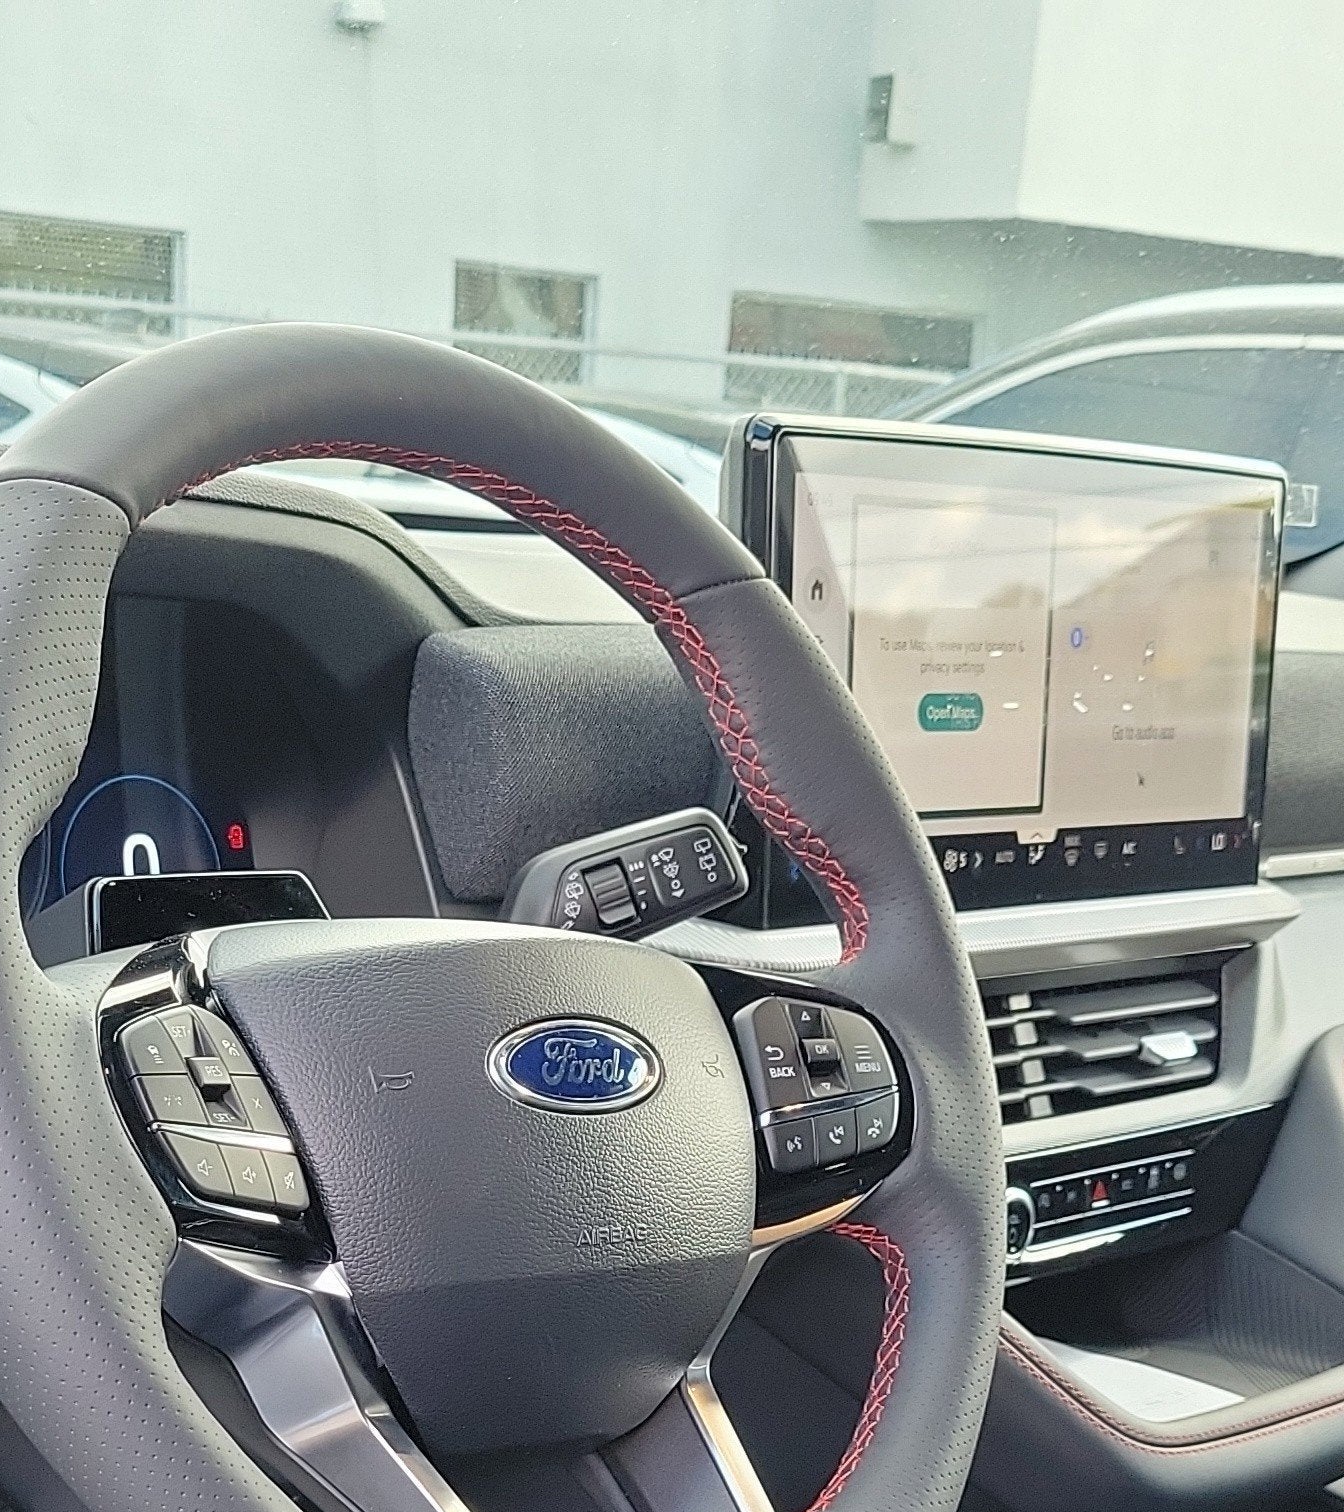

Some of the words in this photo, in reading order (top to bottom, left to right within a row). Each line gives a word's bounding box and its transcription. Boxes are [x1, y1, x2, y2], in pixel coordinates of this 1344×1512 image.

[814, 1044, 829, 1055] OK
[541, 1037, 625, 1087] Ford
[855, 1062, 881, 1073] MENU
[204, 1065, 223, 1077] RES
[768, 1066, 796, 1078] BACK
